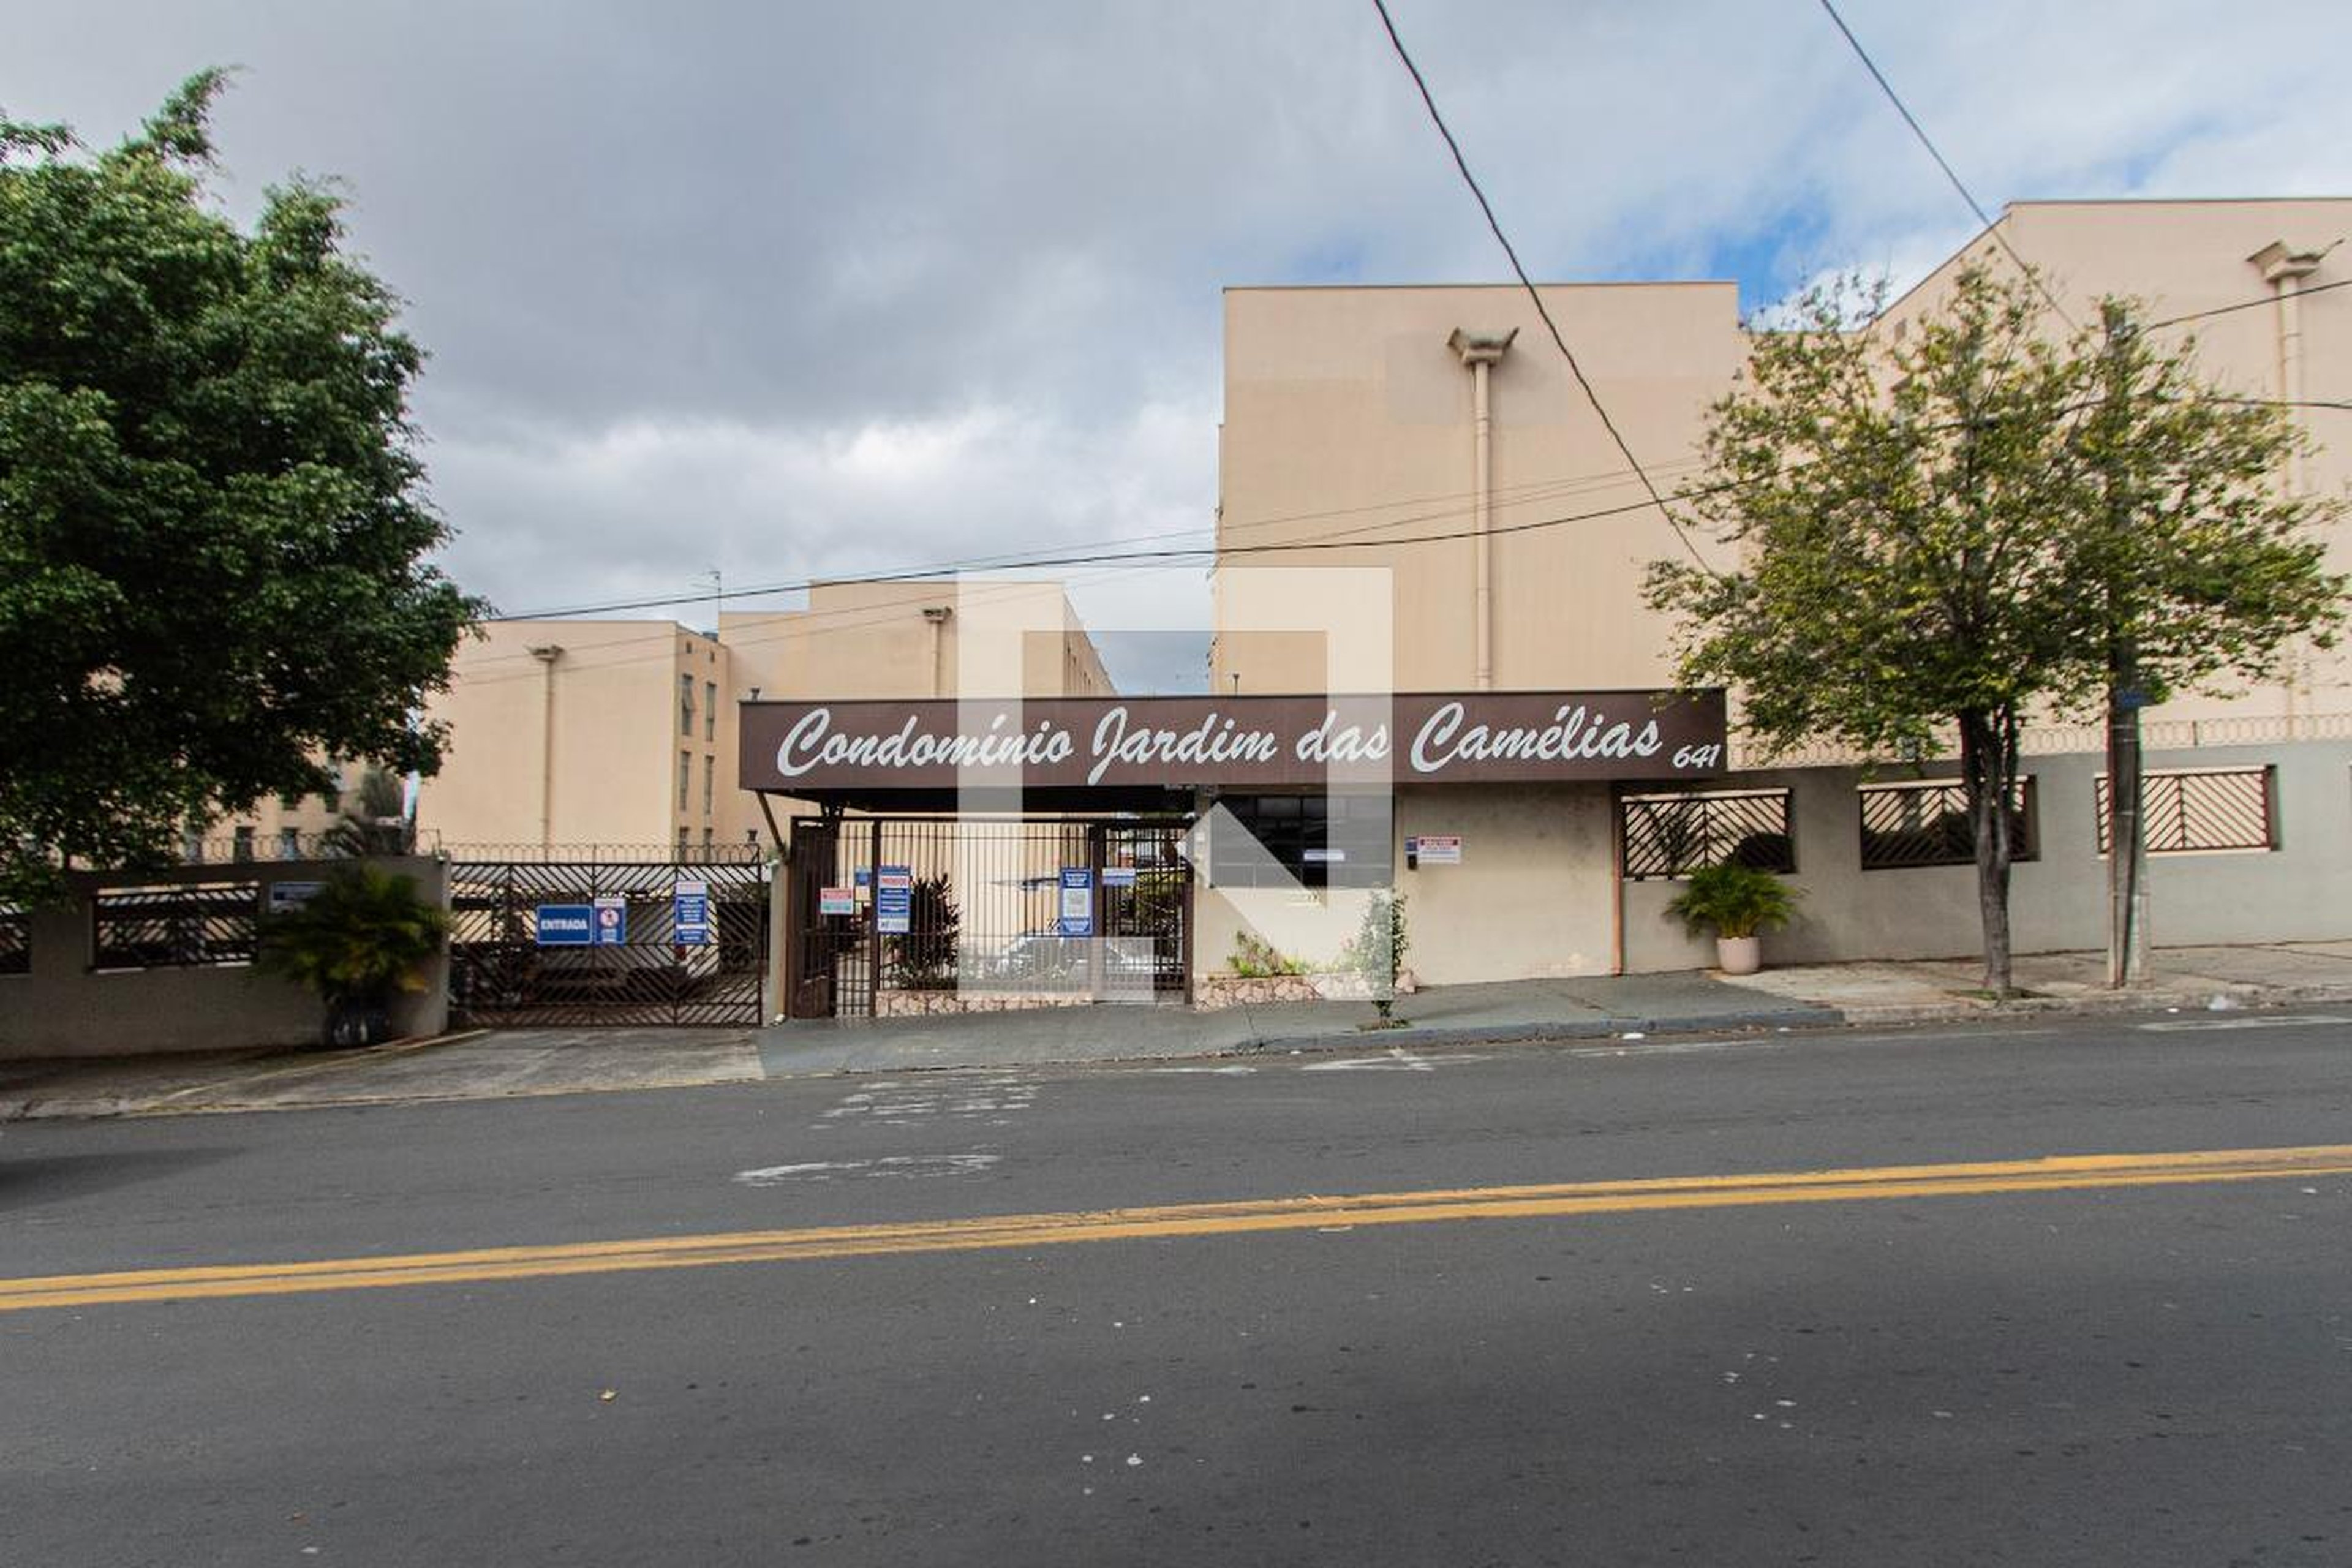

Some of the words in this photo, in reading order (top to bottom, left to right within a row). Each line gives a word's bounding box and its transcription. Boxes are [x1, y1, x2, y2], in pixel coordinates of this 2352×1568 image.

[777, 707, 1073, 777] Condomínio
[1087, 706, 1278, 785] Jardim
[1296, 710, 1390, 763] das
[1409, 701, 1662, 772] Camélias
[1672, 744, 1721, 769] 641
[540, 919, 588, 930] ENTRADA
